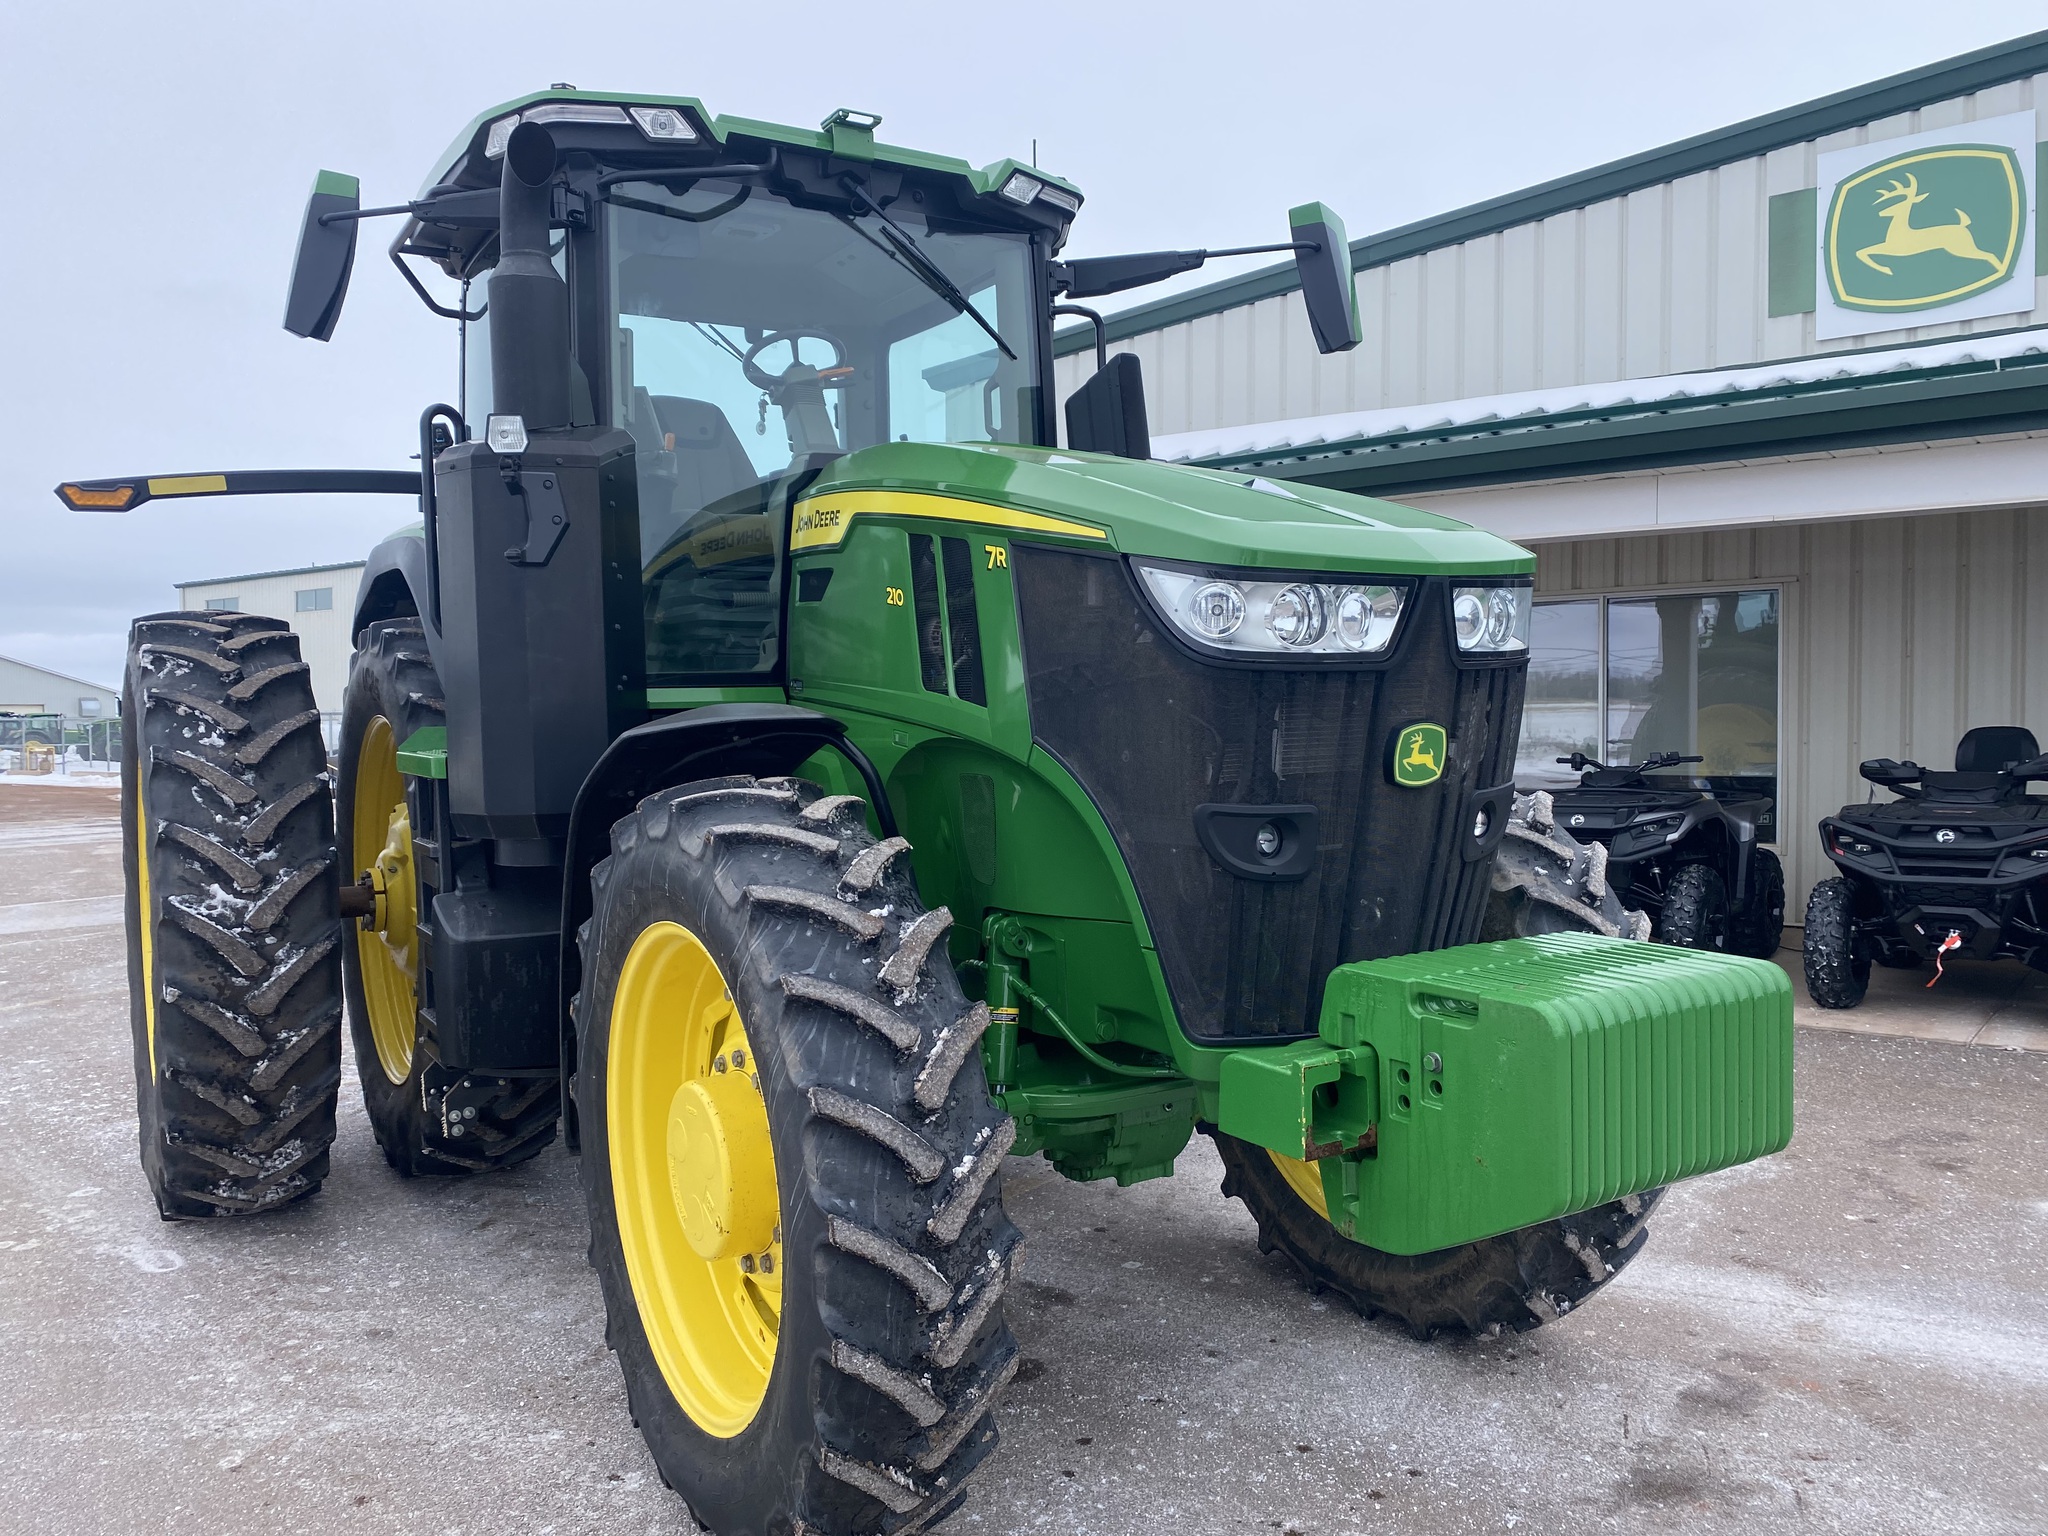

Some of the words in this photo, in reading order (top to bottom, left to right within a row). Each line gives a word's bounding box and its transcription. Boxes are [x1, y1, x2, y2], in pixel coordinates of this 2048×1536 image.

[796, 514, 814, 533] JOHN
[814, 510, 841, 528] DEERE
[985, 545, 1007, 570] 7R
[886, 587, 904, 606] 210
